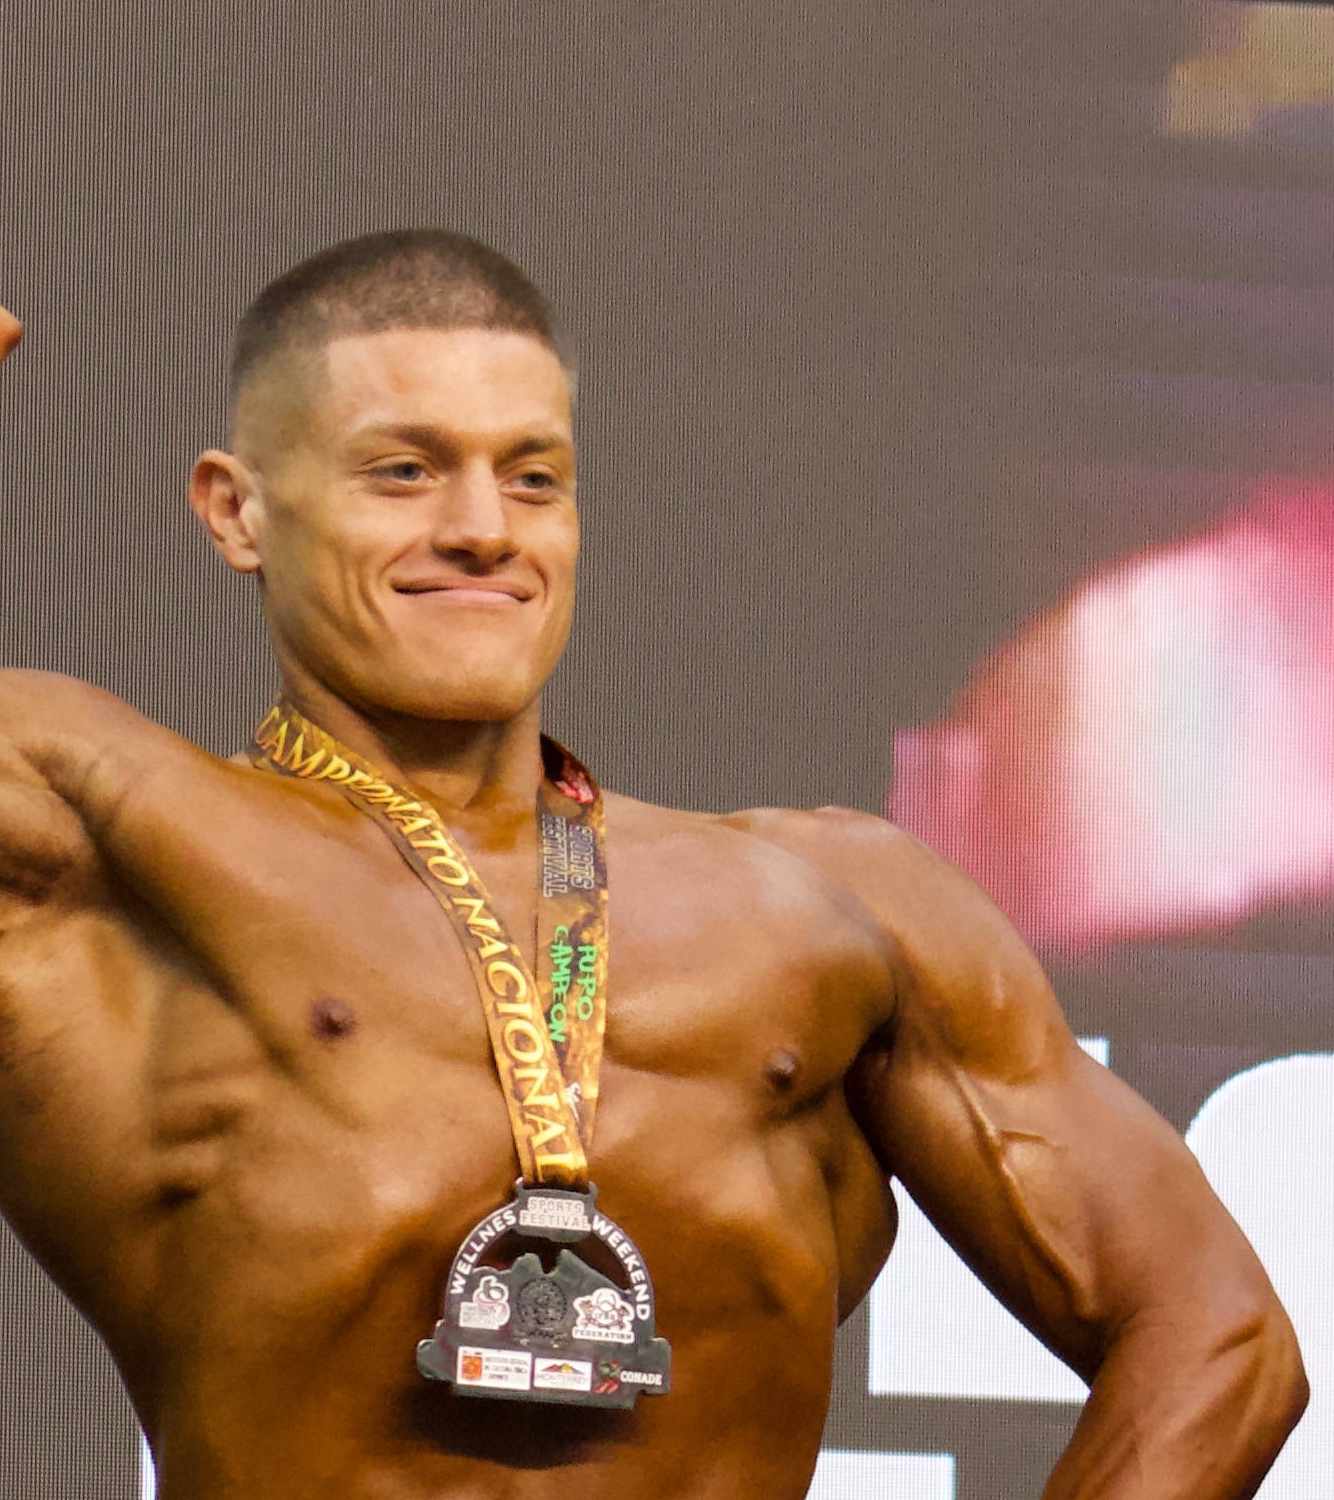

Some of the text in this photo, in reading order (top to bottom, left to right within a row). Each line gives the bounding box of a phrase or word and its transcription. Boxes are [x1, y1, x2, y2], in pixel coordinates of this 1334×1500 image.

[255, 706, 588, 1184] CAMPEONATO NACIONAL
[520, 1211, 590, 1229] FESTIVAL
[529, 1198, 584, 1213] SPORTS
[450, 1209, 517, 1295] WELLNES
[591, 1214, 652, 1321] WEEKEND
